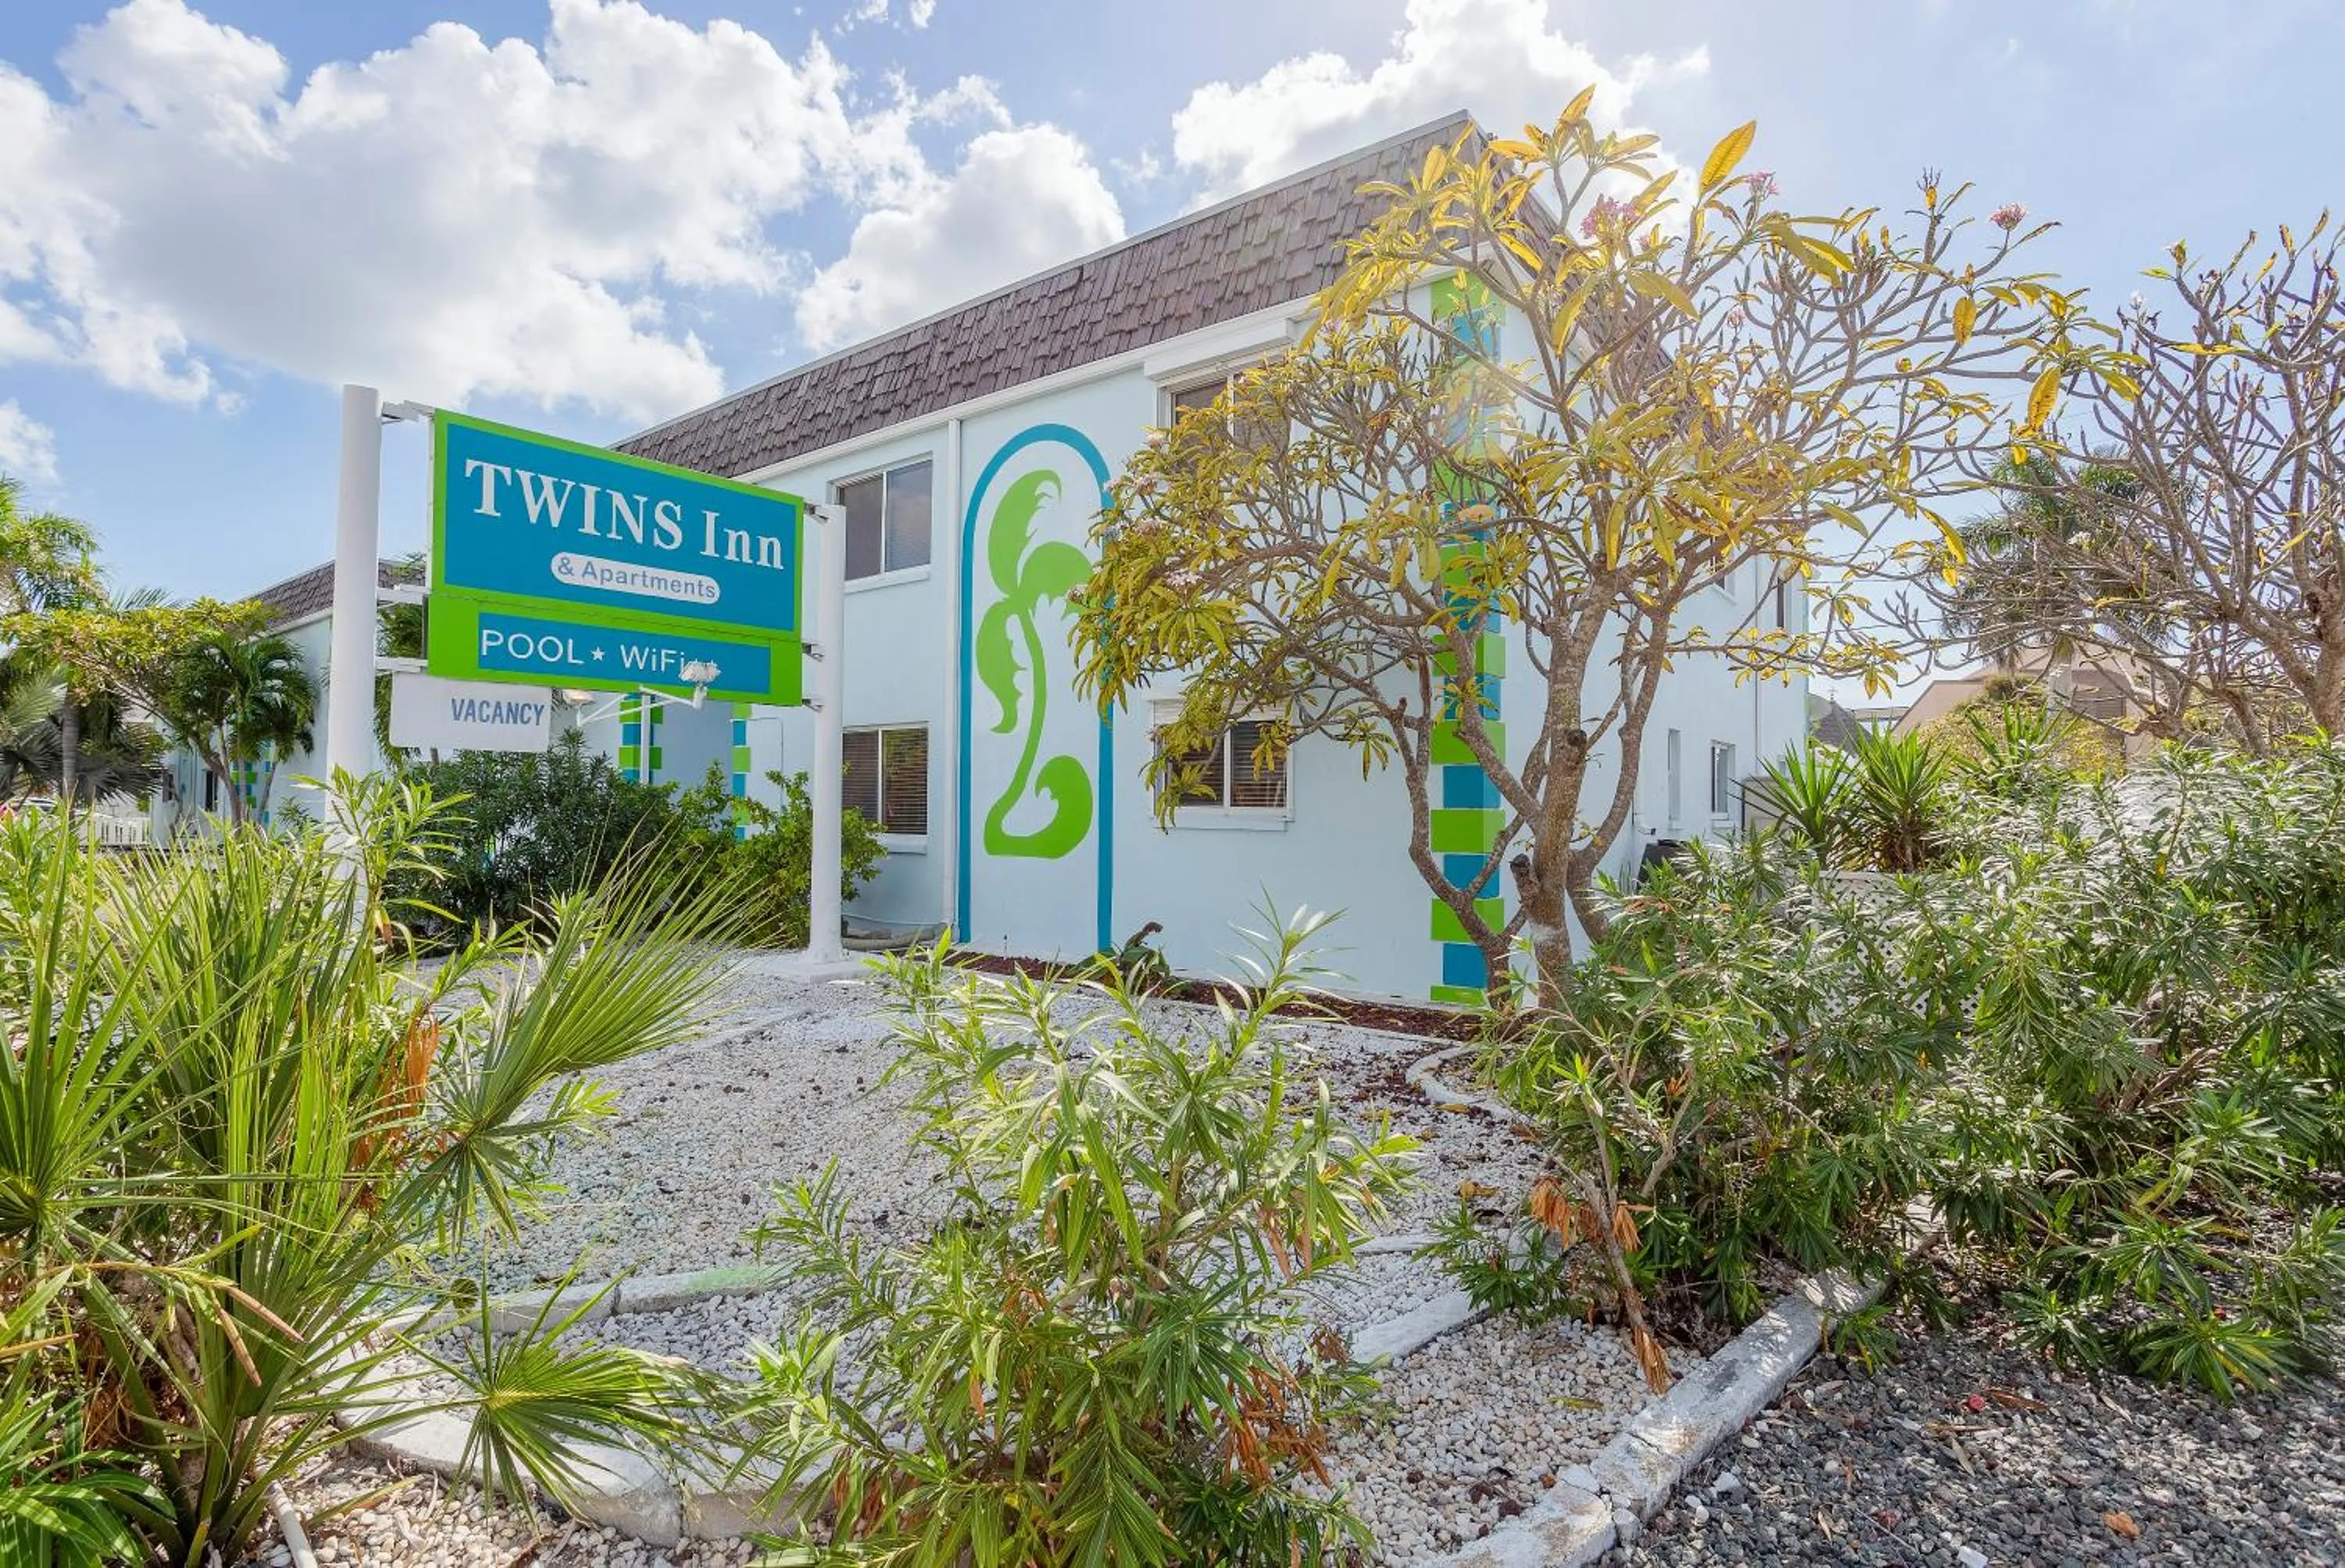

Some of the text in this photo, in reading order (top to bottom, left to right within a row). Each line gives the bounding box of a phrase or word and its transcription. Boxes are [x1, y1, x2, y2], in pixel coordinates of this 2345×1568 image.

[465, 459, 784, 570] TWINS Inn
[557, 556, 716, 599] & Apartments
[481, 629, 686, 675] POOL WiFi
[451, 698, 545, 726] VACANCY
